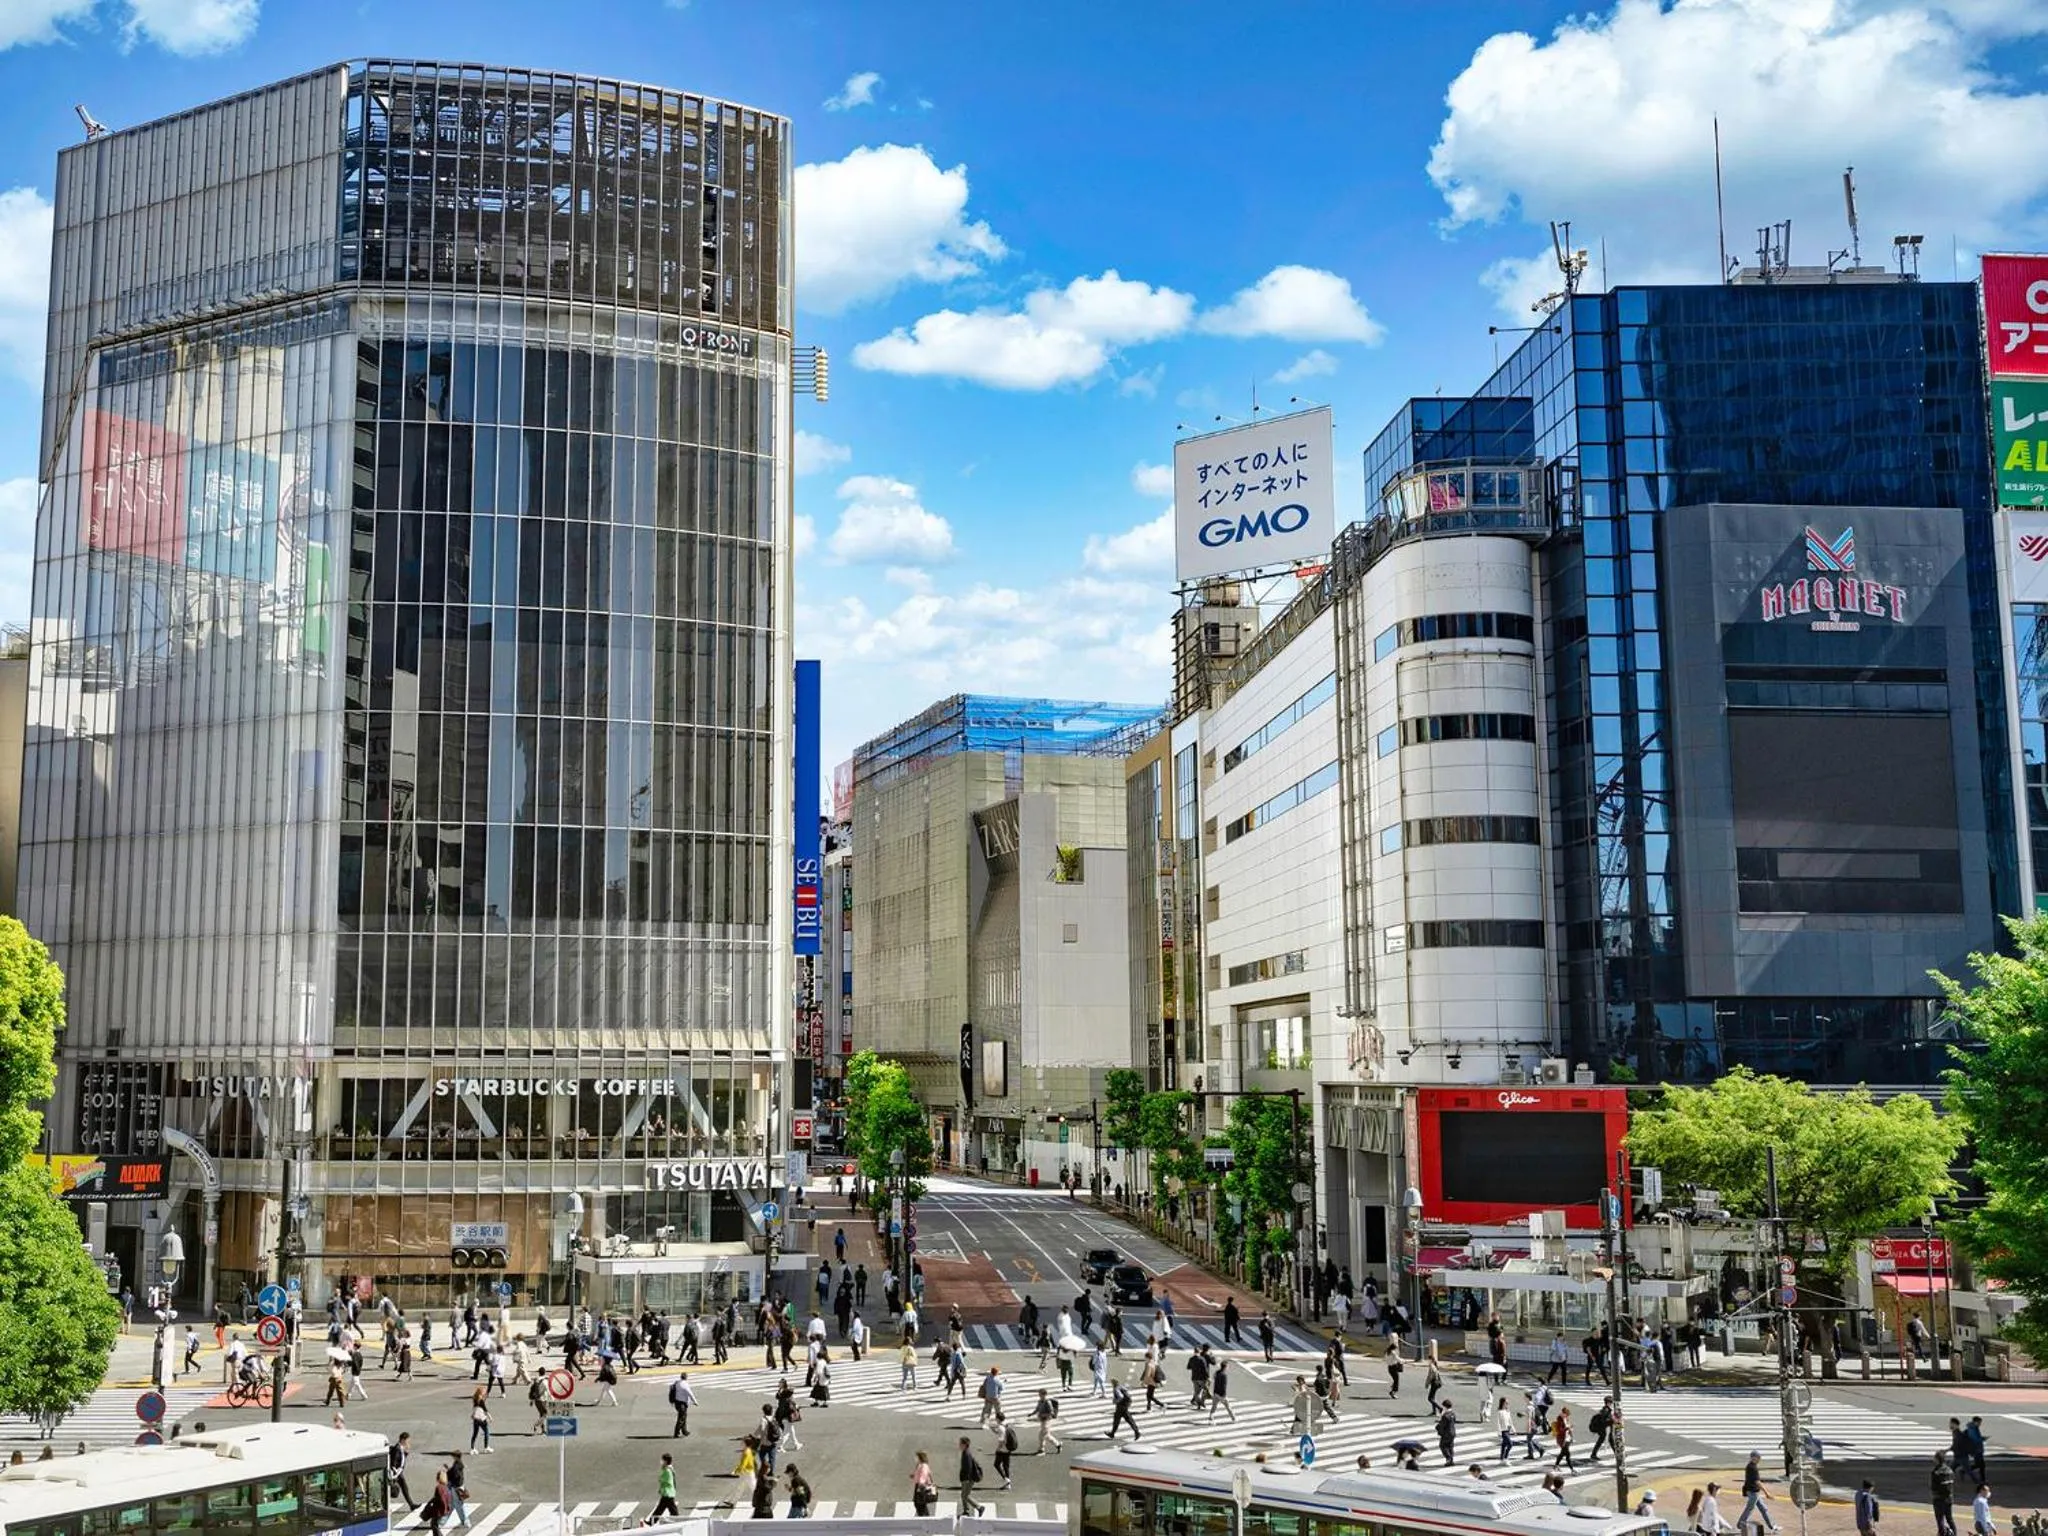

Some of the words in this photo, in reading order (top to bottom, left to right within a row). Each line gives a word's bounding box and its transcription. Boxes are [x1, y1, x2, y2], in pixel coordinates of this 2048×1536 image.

[1197, 443, 1308, 484] すべての人に
[1197, 469, 1308, 508] インターネット
[1198, 504, 1310, 547] GMO
[1762, 576, 1907, 623] MAGNET
[796, 857, 818, 939] SEIBU
[962, 1031, 971, 1069] ZARA
[196, 1076, 305, 1098] TSUTAYA
[435, 1078, 578, 1097] STARBUCKS
[593, 1079, 675, 1097] COFFEE
[1498, 1091, 1541, 1109] Glico
[119, 1163, 162, 1183] ALVARK
[652, 1162, 768, 1189] TSUTAYA
